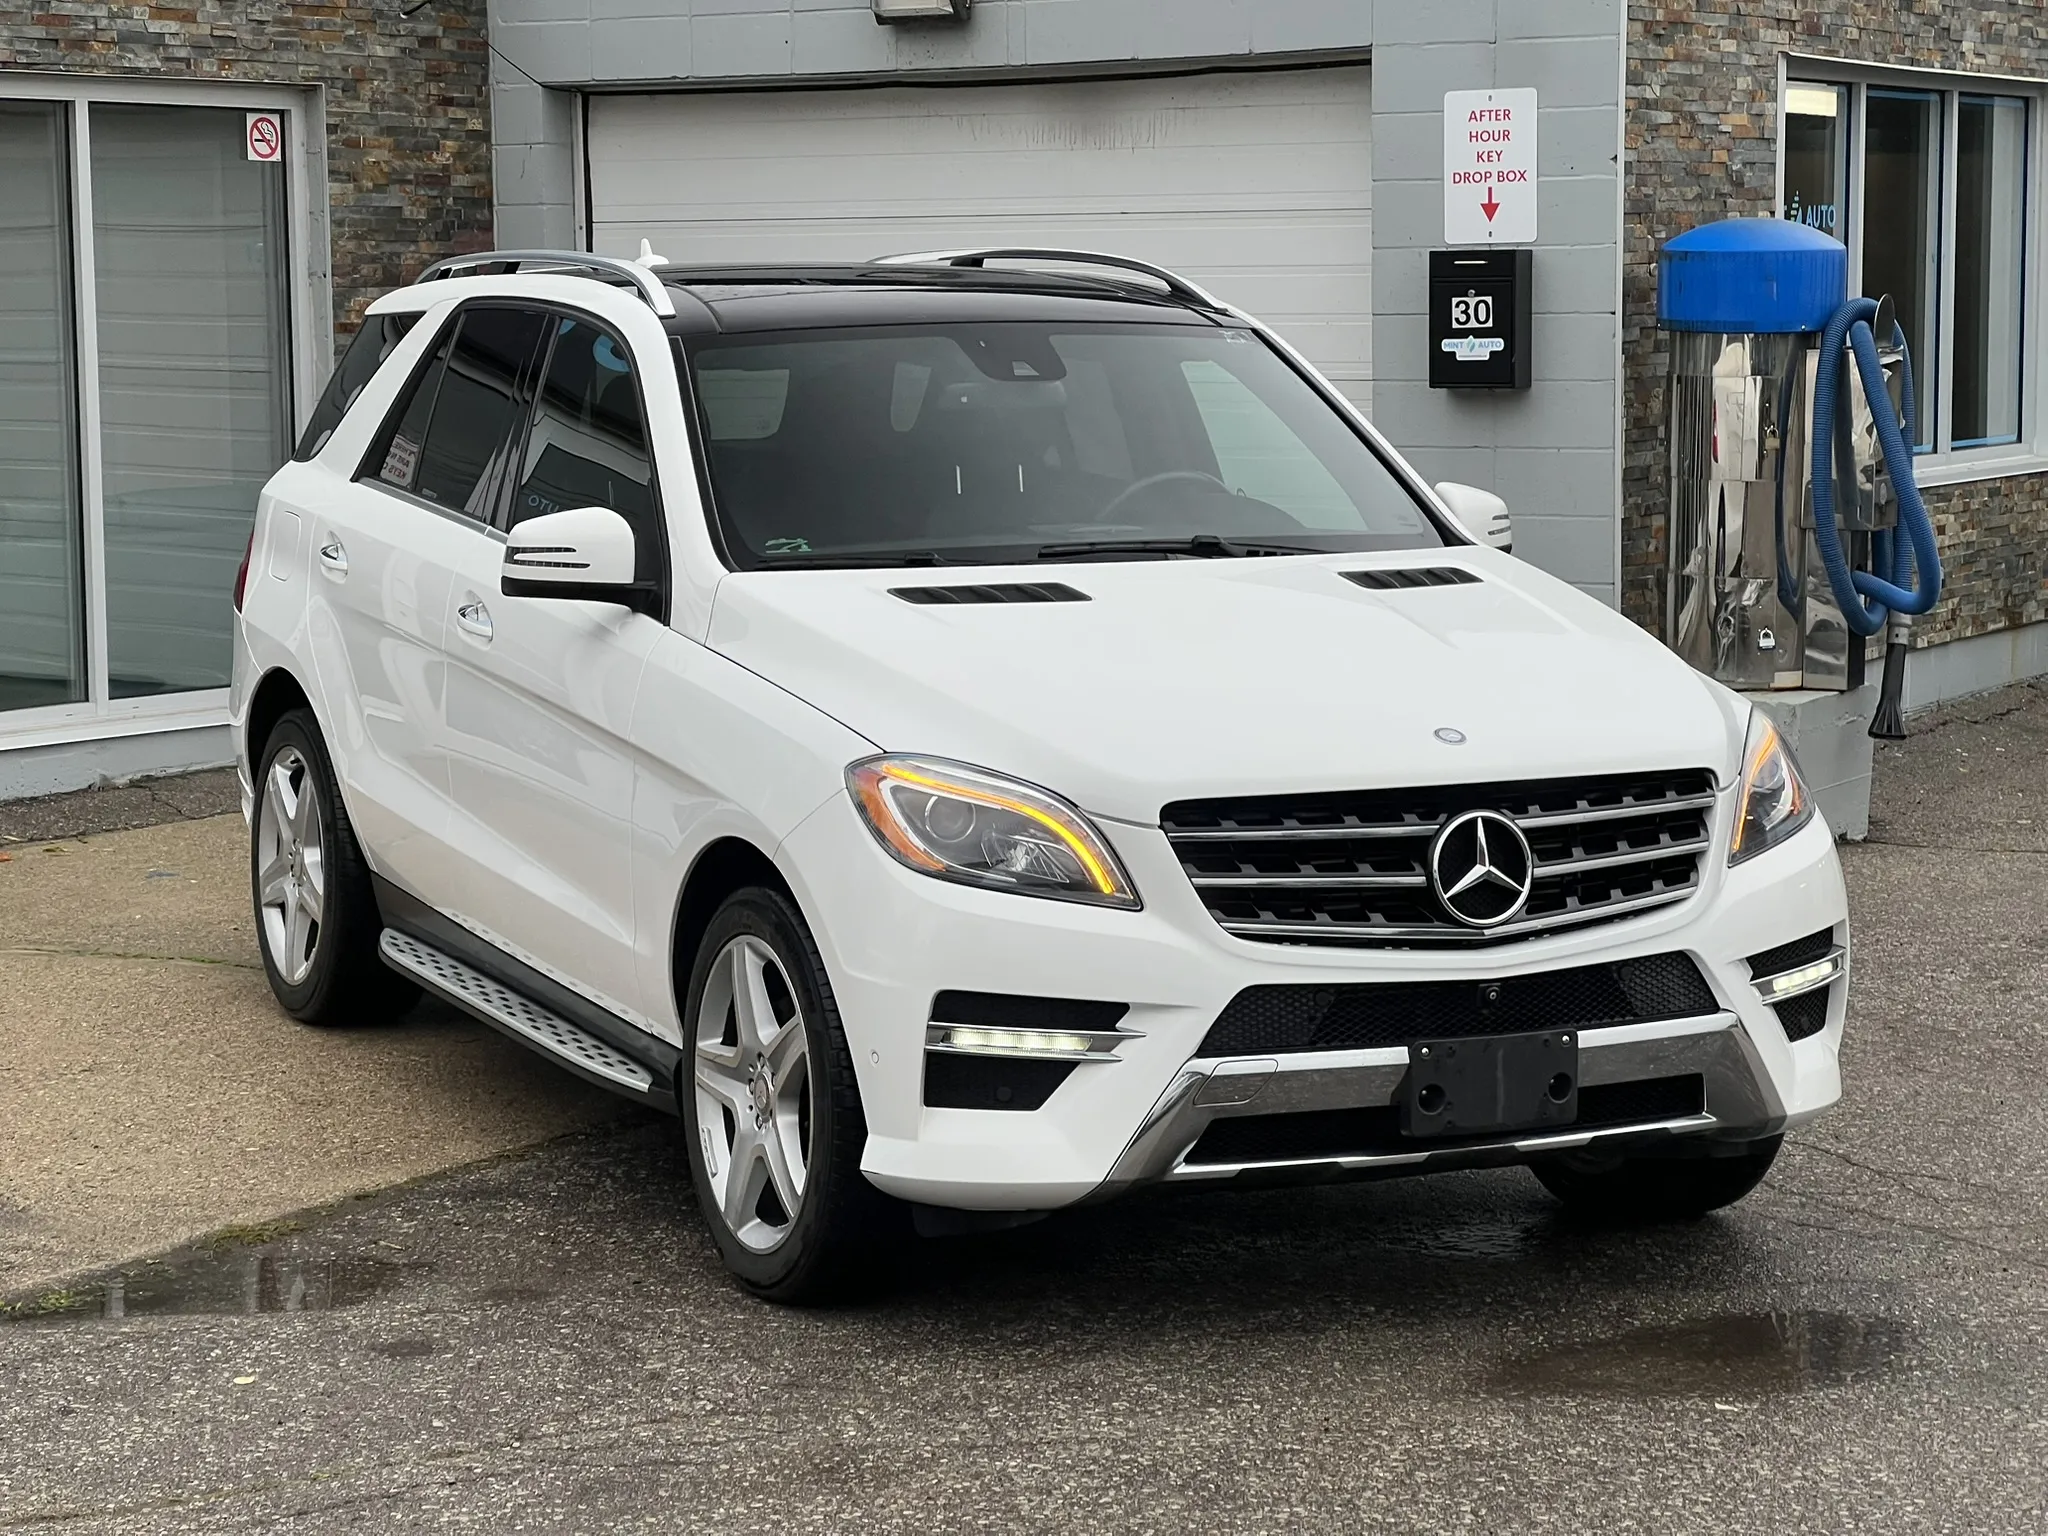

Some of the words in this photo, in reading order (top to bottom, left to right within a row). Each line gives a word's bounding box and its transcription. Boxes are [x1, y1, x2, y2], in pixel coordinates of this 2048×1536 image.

[1468, 108, 1511, 122] AFTER
[1469, 129, 1511, 143] HOUR
[1476, 150, 1503, 163] KEY
[1452, 171, 1493, 184] DROP
[1497, 170, 1527, 183] BOX
[1804, 204, 1836, 228] AUTO
[1454, 299, 1491, 326] 30
[1443, 341, 1465, 349] MINT
[1478, 340, 1502, 348] AUTO
